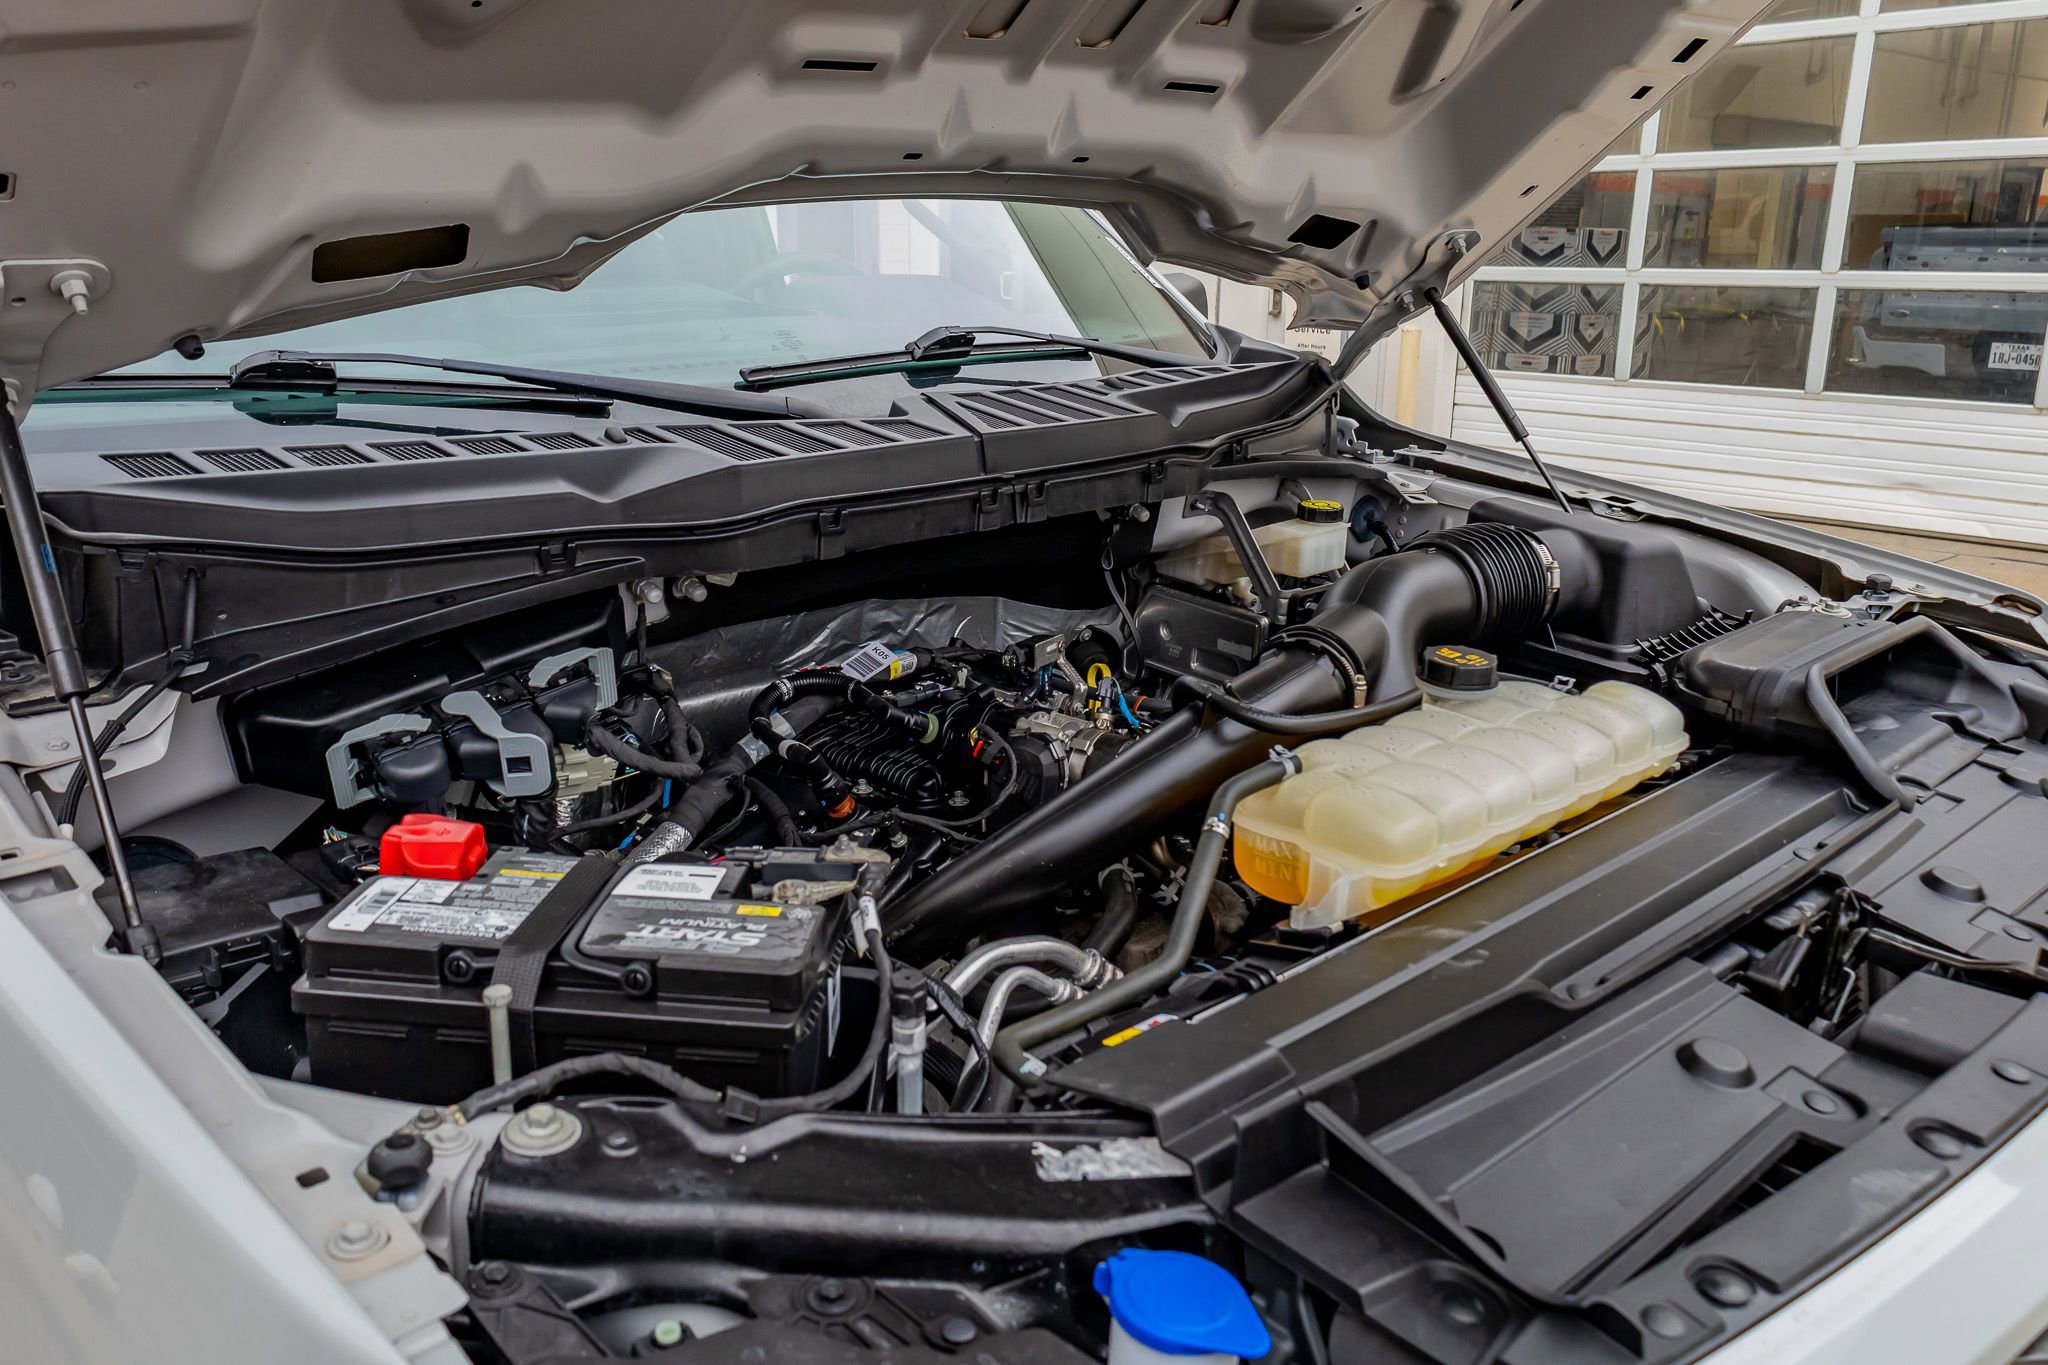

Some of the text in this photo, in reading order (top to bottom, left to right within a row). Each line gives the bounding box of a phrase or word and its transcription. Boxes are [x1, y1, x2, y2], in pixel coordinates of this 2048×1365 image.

[871, 645, 890, 660] K05
[1255, 834, 1297, 860] MAX
[1255, 856, 1293, 881] MIN
[625, 923, 767, 947] START
[659, 917, 768, 931] PLATINUM
